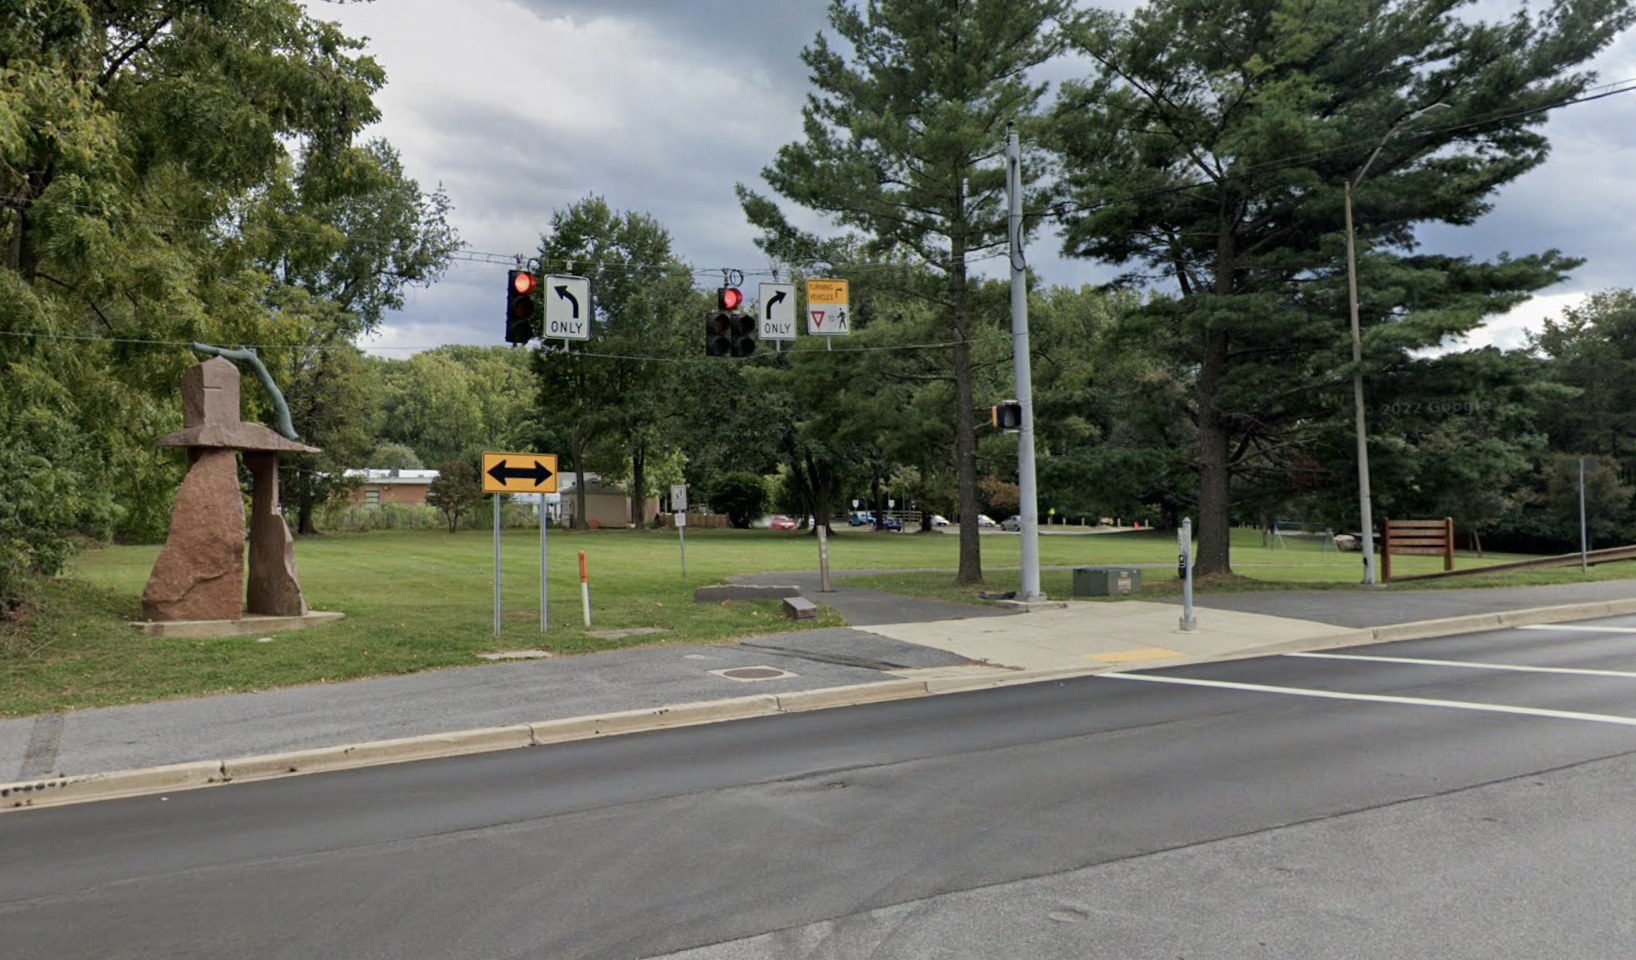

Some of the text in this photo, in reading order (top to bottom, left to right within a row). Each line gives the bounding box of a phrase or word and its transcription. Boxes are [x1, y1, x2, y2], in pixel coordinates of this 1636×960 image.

[809, 283, 834, 291] TURNING
[551, 320, 583, 334] ONLY
[764, 323, 792, 334] ONLY
